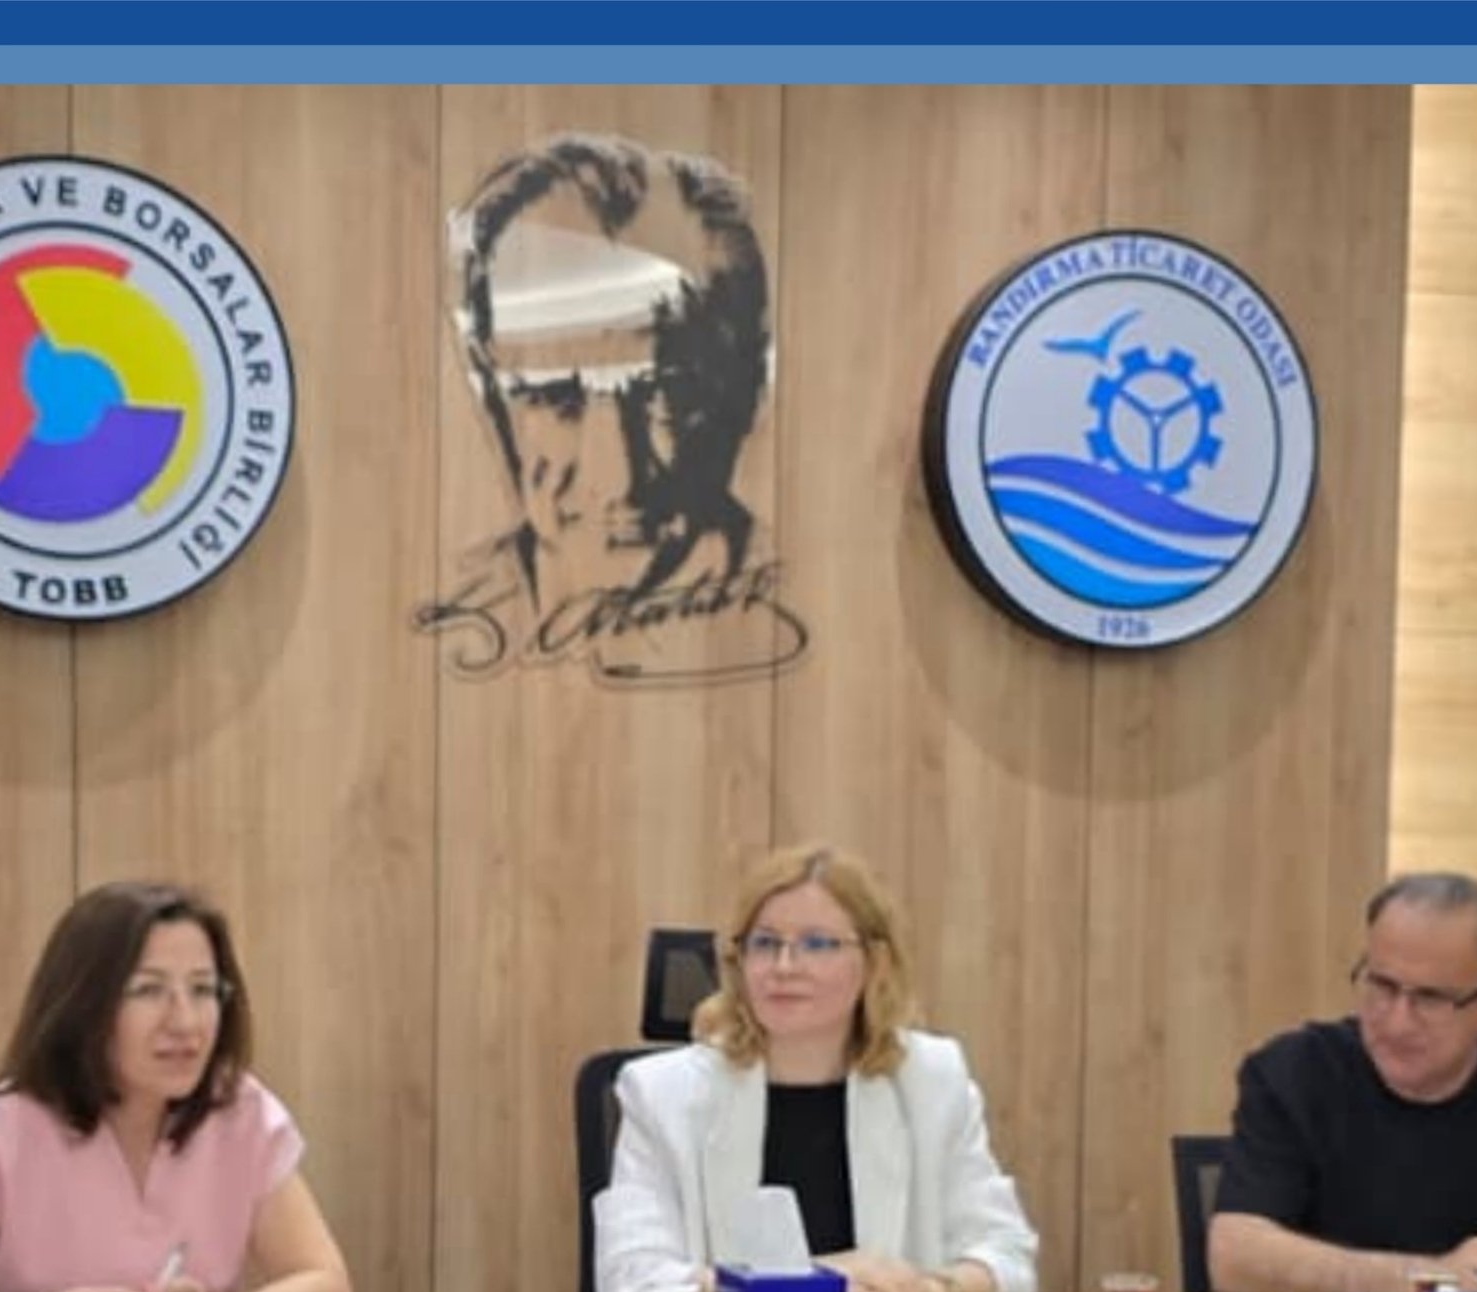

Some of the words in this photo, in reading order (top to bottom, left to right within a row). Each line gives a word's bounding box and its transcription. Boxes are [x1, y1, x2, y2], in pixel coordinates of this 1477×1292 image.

[20, 176, 79, 206] VE
[103, 184, 273, 387] BORSALAR
[967, 247, 1104, 369] BANDIRMA
[1111, 237, 1237, 311] TİCARET
[1236, 297, 1298, 387] ODASI
[180, 409, 276, 570] BİRLİĞİ
[10, 568, 129, 605] TOBB
